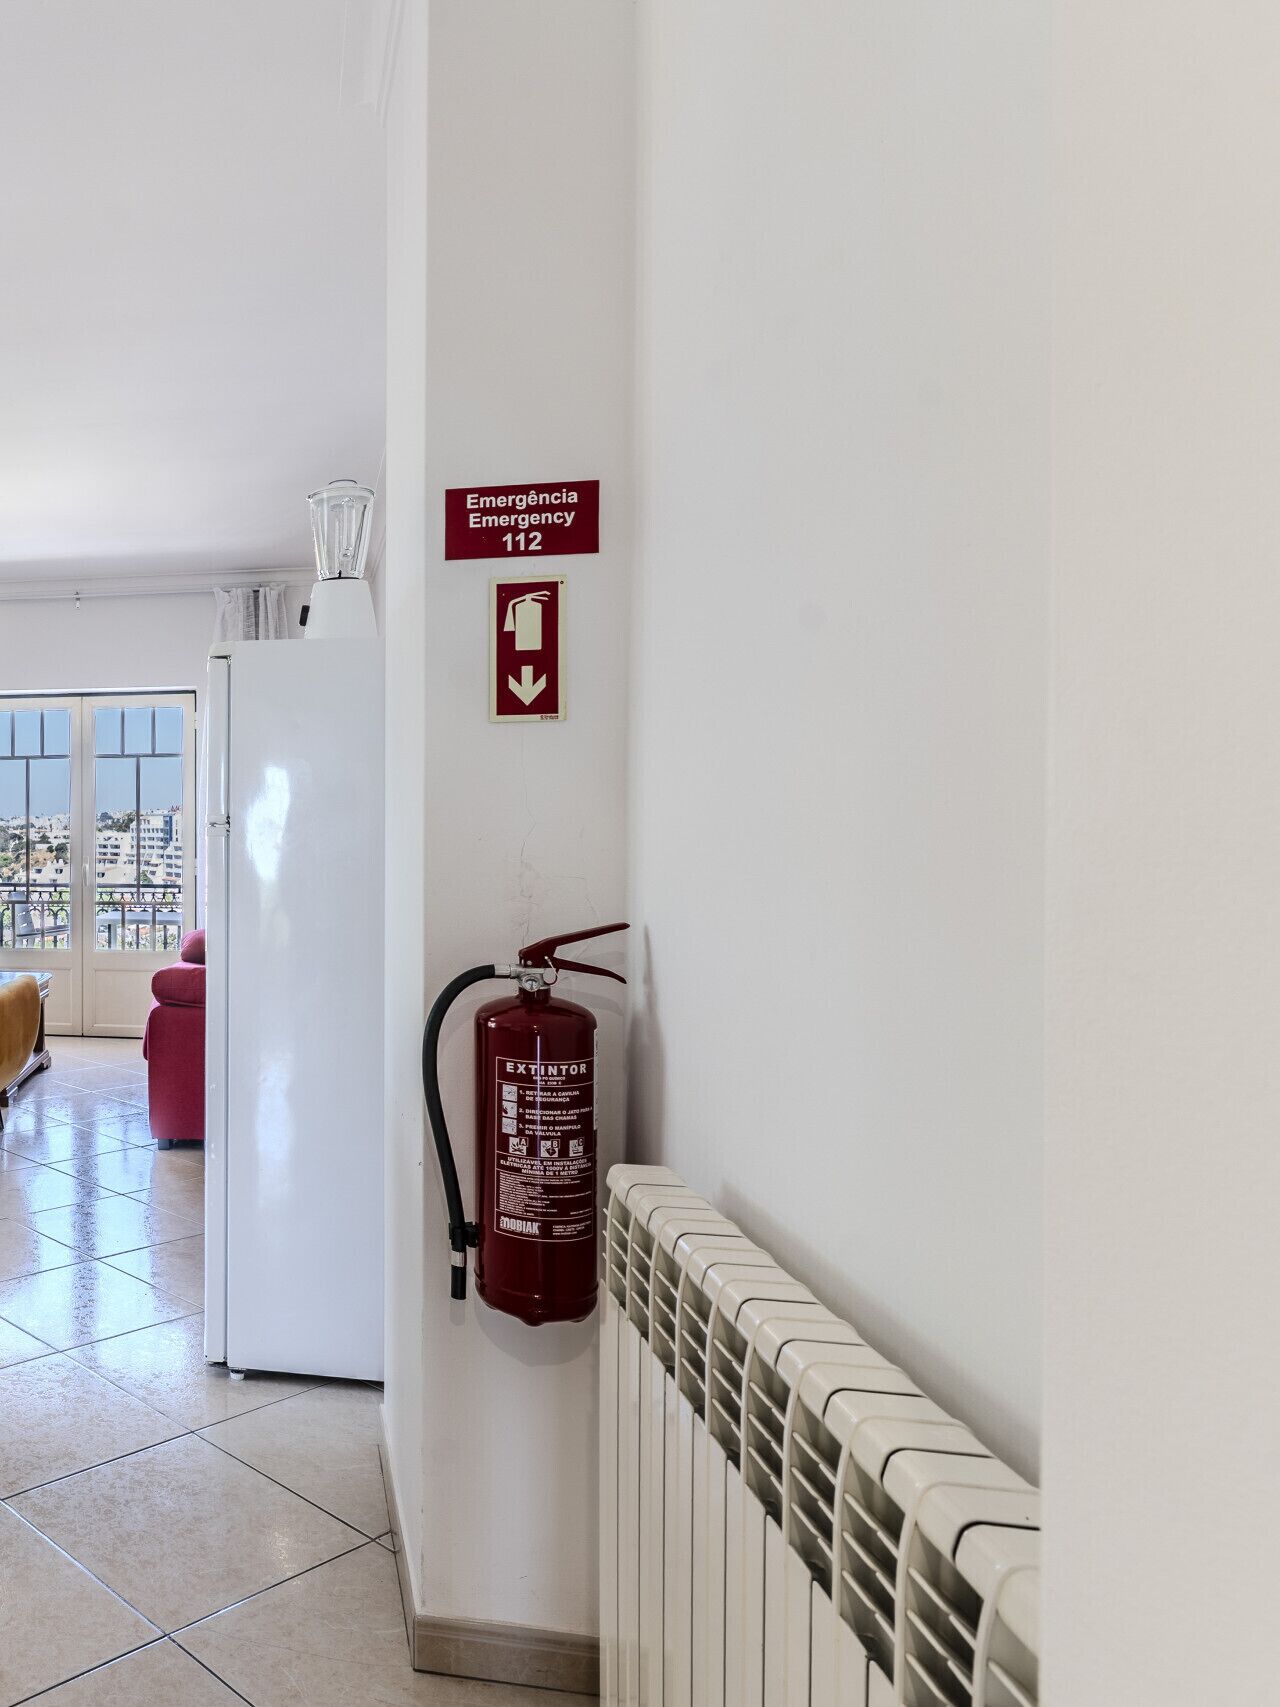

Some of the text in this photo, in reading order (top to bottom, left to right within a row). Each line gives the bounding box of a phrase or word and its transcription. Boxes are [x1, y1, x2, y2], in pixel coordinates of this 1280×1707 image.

[466, 489, 578, 510] Emergência
[468, 509, 576, 528] Emergency
[502, 531, 542, 552] 112
[506, 1062, 587, 1075] EXTINTOR
[520, 1138, 526, 1146] A
